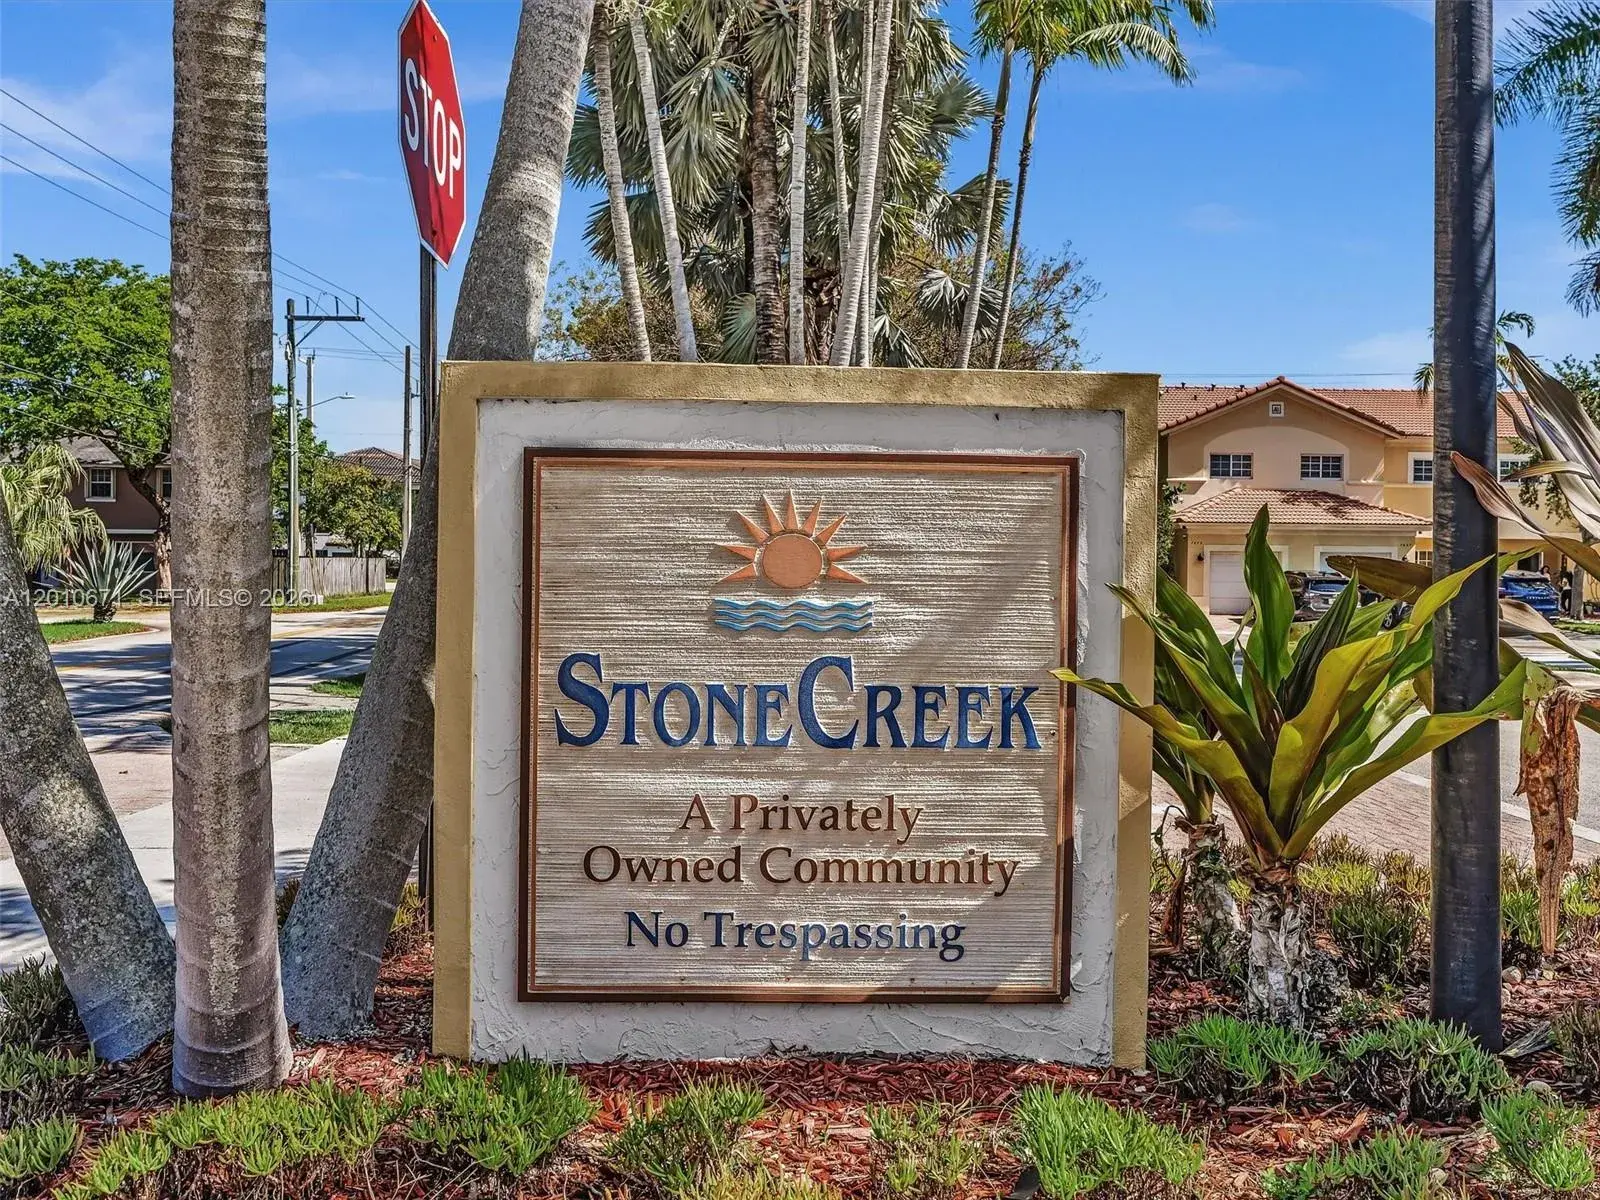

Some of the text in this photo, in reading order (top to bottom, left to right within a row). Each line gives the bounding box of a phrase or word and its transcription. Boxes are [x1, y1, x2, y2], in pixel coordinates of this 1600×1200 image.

[404, 57, 462, 200] STOP
[679, 793, 924, 845] A Privately
[583, 845, 1022, 898] Owned Community
[624, 910, 967, 963] No Trespassing
